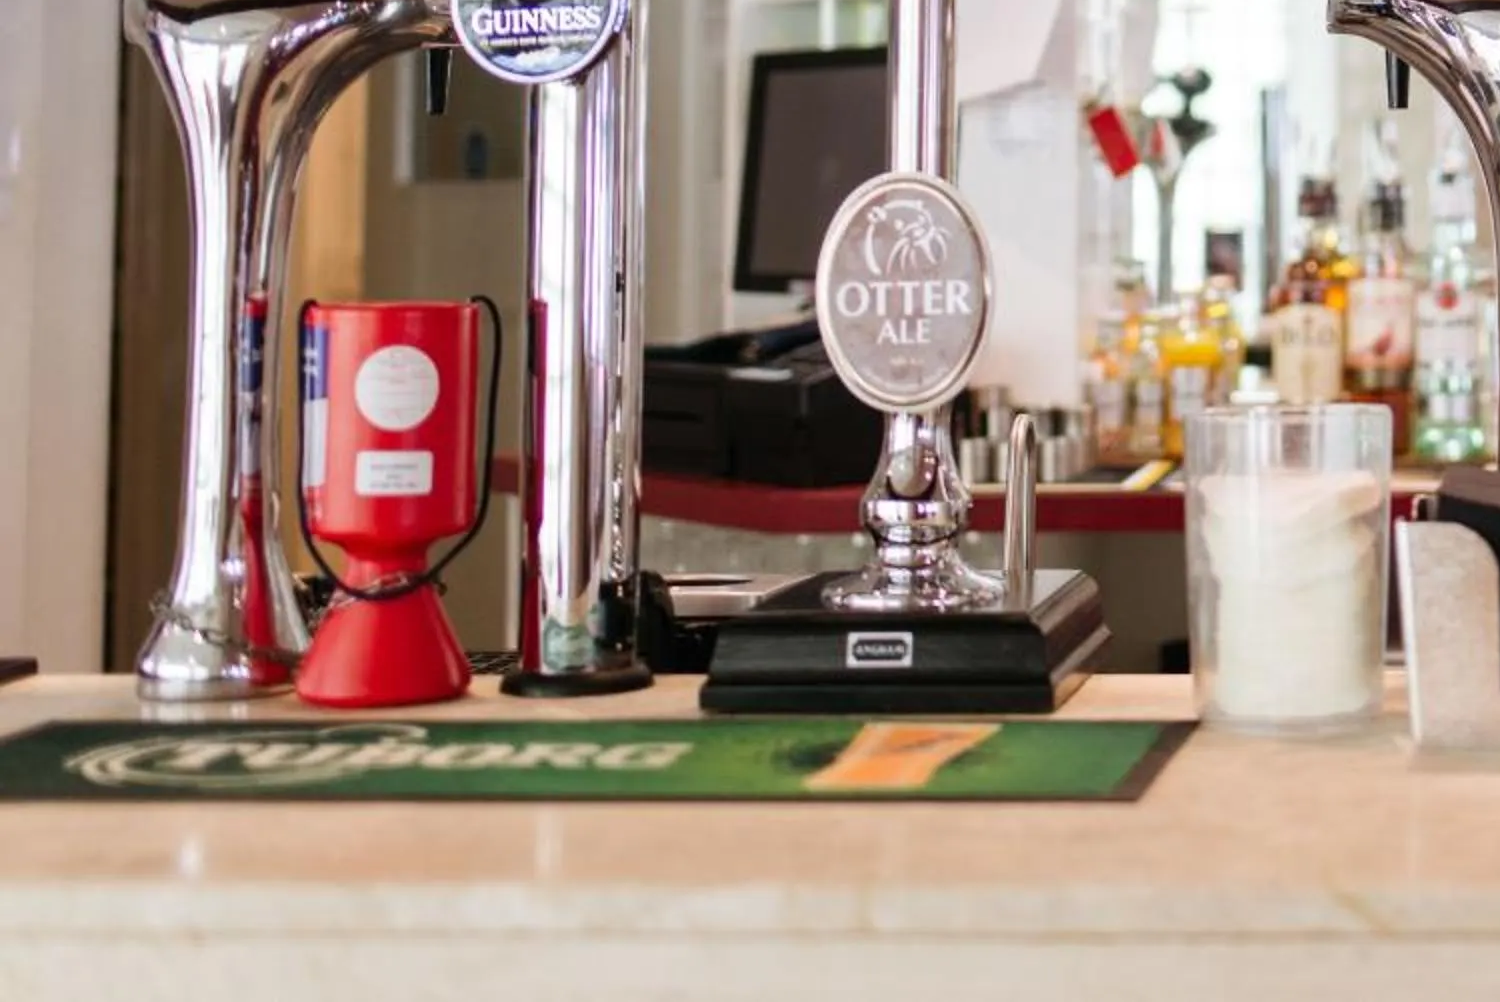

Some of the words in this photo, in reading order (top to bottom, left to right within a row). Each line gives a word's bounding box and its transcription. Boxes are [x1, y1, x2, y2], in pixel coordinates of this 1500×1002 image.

[471, 5, 603, 35] GUINNESS
[836, 279, 972, 318] OTTER
[877, 319, 932, 344] ALE
[160, 740, 695, 769] TUBORG
